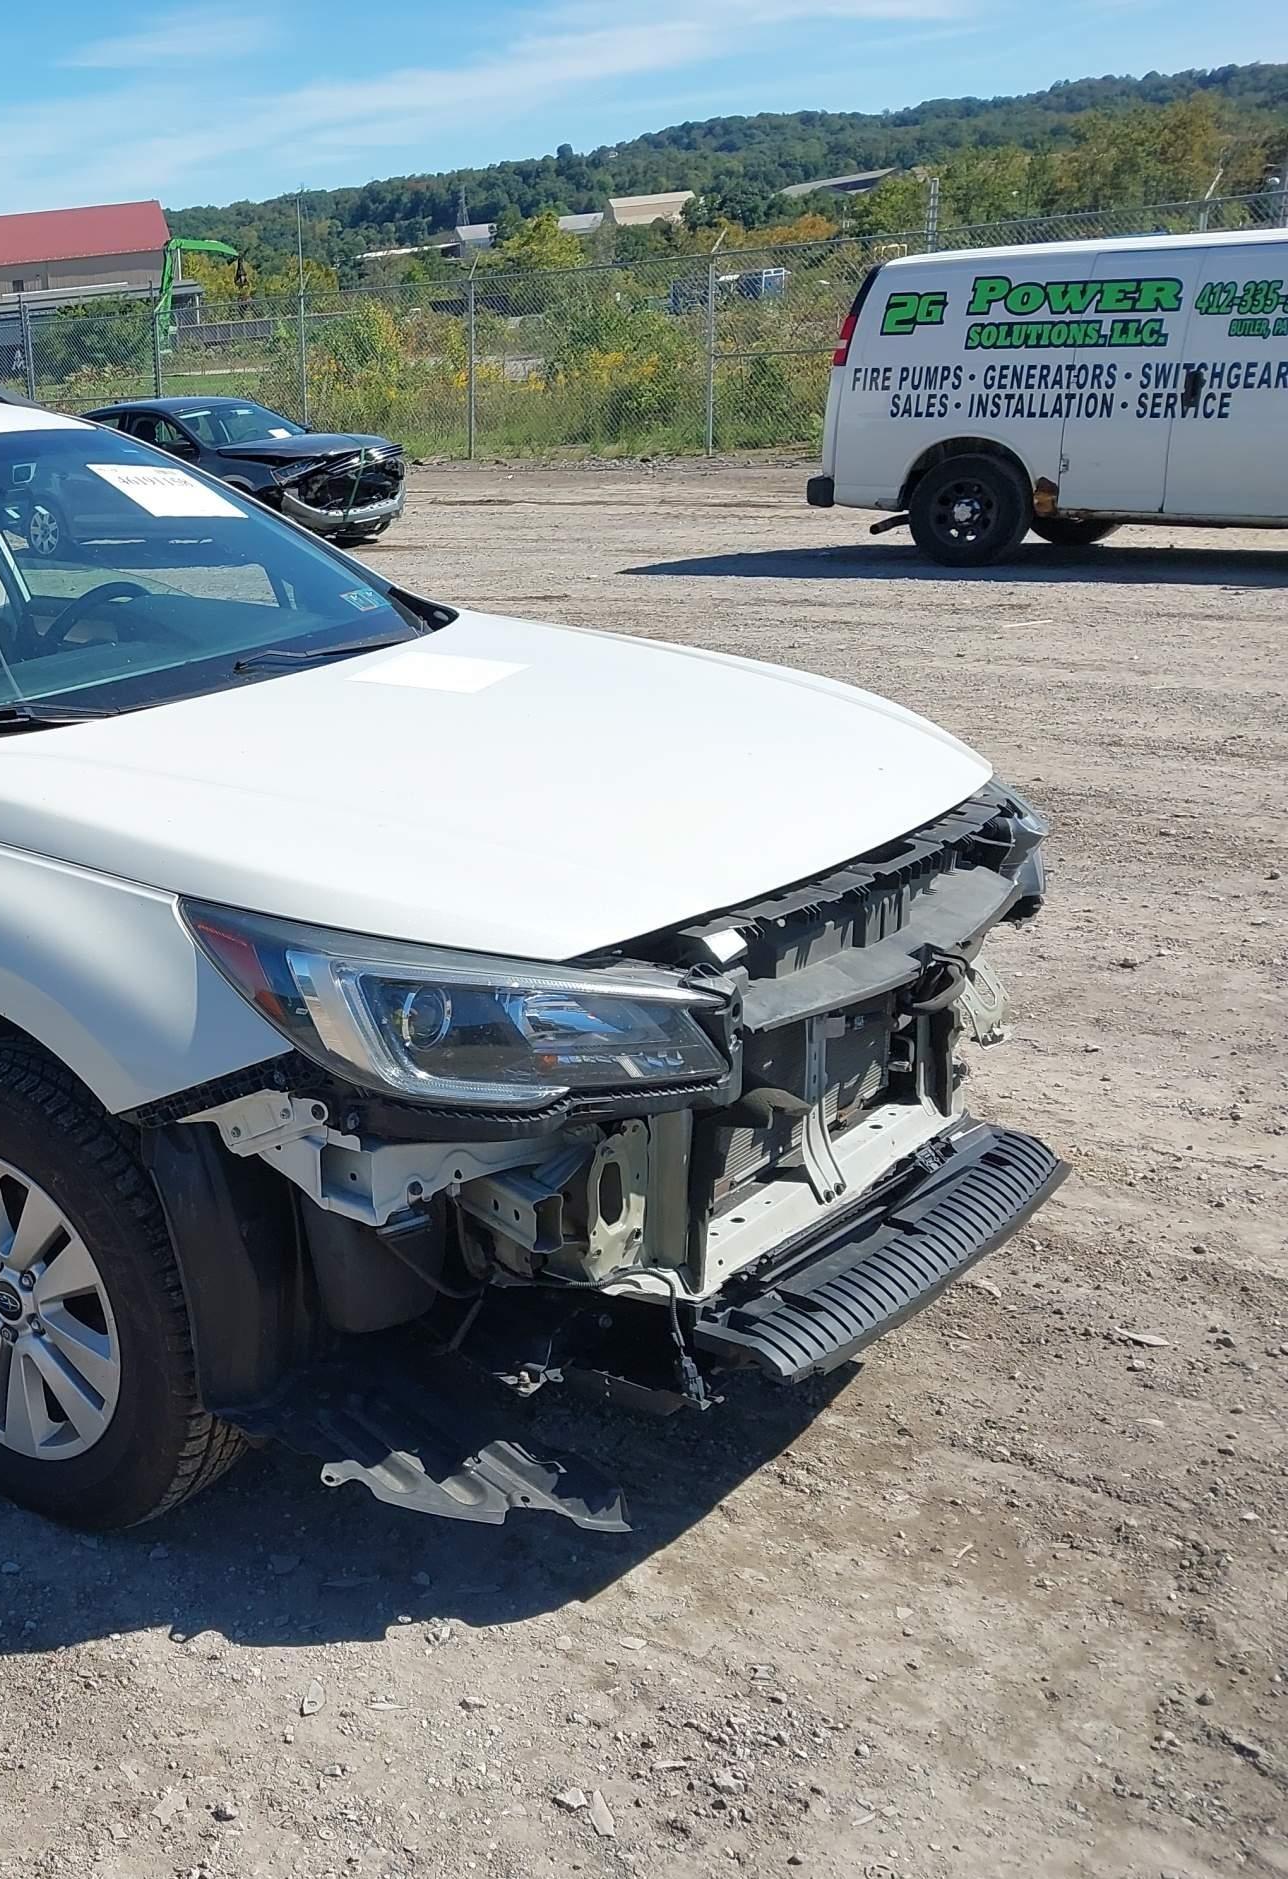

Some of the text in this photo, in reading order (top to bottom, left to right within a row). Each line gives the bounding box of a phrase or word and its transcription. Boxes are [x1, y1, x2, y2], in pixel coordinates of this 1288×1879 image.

[880, 276, 1183, 336] 2G POWER
[1228, 318, 1271, 339] BUTLER,
[852, 367, 892, 391] FIRE
[899, 365, 963, 390] PUMPS
[983, 363, 1117, 388] GENERATORS
[890, 393, 949, 418] SALES
[968, 392, 1114, 418] INSTALLATION
